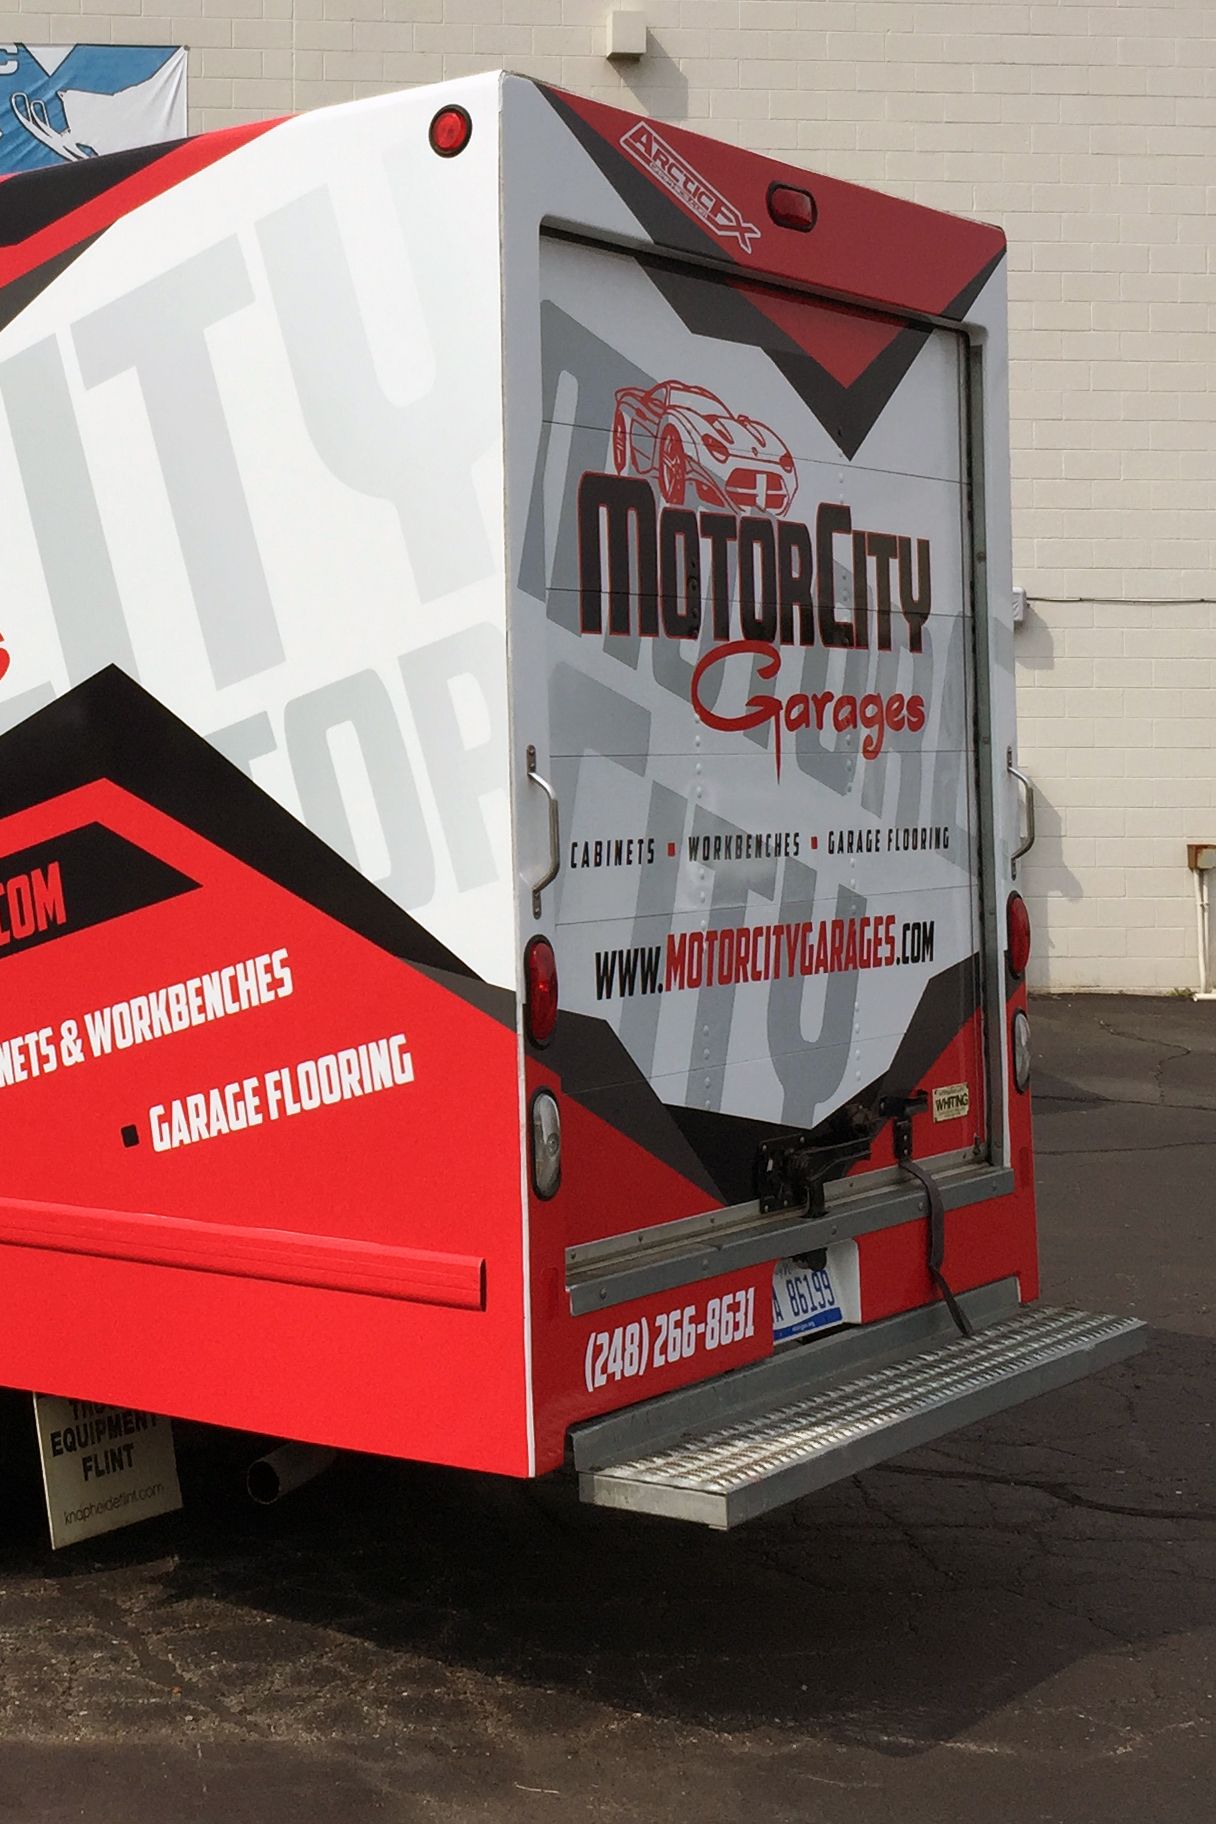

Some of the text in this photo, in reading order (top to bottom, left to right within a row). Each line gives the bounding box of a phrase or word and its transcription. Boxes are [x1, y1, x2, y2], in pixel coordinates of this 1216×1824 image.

[691, 640, 926, 785] Garages
[570, 826, 950, 869] CABINETS WORKBENCHES GARAGE FLOORING
[61, 1018, 84, 1067] &
[84, 947, 294, 1058] WORKBENCHES
[594, 914, 935, 1001] WWW.MOTORCITYGARAGES.COM
[149, 1033, 415, 1152] GARAGE FLOORING
[584, 1286, 755, 1392] (248) 266-8631
[82, 1443, 135, 1481] FLINT
